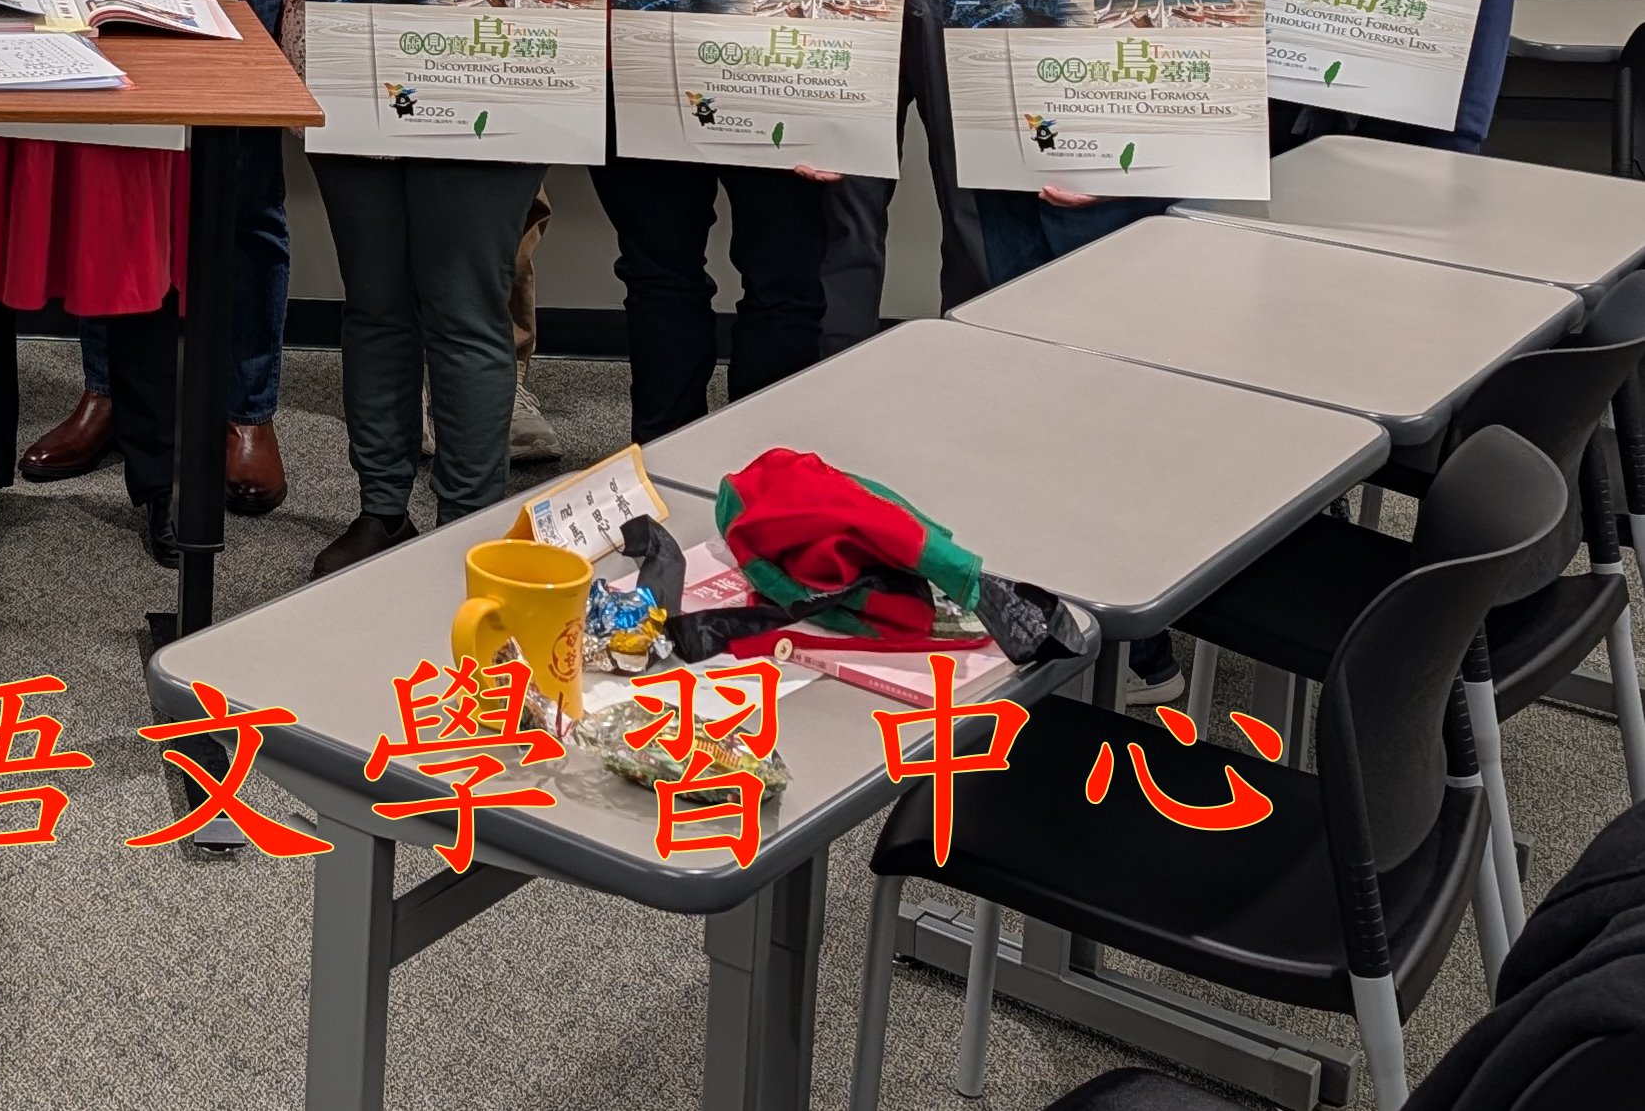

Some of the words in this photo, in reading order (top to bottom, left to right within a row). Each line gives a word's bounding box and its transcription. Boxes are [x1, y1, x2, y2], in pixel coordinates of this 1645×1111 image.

[1285, 2, 1363, 27] DISCOVERING
[1365, 16, 1420, 37] FORMOSA
[504, 22, 559, 38] TAIWAN
[1265, 12, 1322, 32] THROUGH
[1323, 22, 1348, 37] THE
[1350, 27, 1405, 47] OVERSEAS
[1408, 36, 1437, 53] LENS
[799, 33, 853, 49] TAIWAN
[1149, 44, 1211, 59] TAIWAN
[1266, 47, 1308, 64] 2026
[424, 59, 500, 73] DISCOVERING
[503, 61, 556, 75] FORMOSA
[405, 72, 462, 85] THROUGH
[463, 74, 488, 85] THE
[489, 74, 545, 87] OVERSEAS
[547, 76, 575, 88] LENS
[721, 69, 794, 85] DISCOVERING
[796, 74, 848, 88] FORMOSA
[704, 81, 758, 95] THROUGH
[759, 84, 782, 96] THE
[783, 85, 836, 100] OVERSEAS
[839, 88, 866, 101] LENS
[1064, 87, 1147, 101] DISCOVERING
[1150, 88, 1210, 101] FORMOSA
[415, 106, 455, 118] 2026
[1044, 102, 1104, 115] THROUGH
[1107, 102, 1134, 115] THE
[1135, 101, 1197, 115] OVERSEAS
[1200, 103, 1232, 115] LENS
[716, 115, 753, 127] 2026
[1058, 139, 1099, 151] 2026
